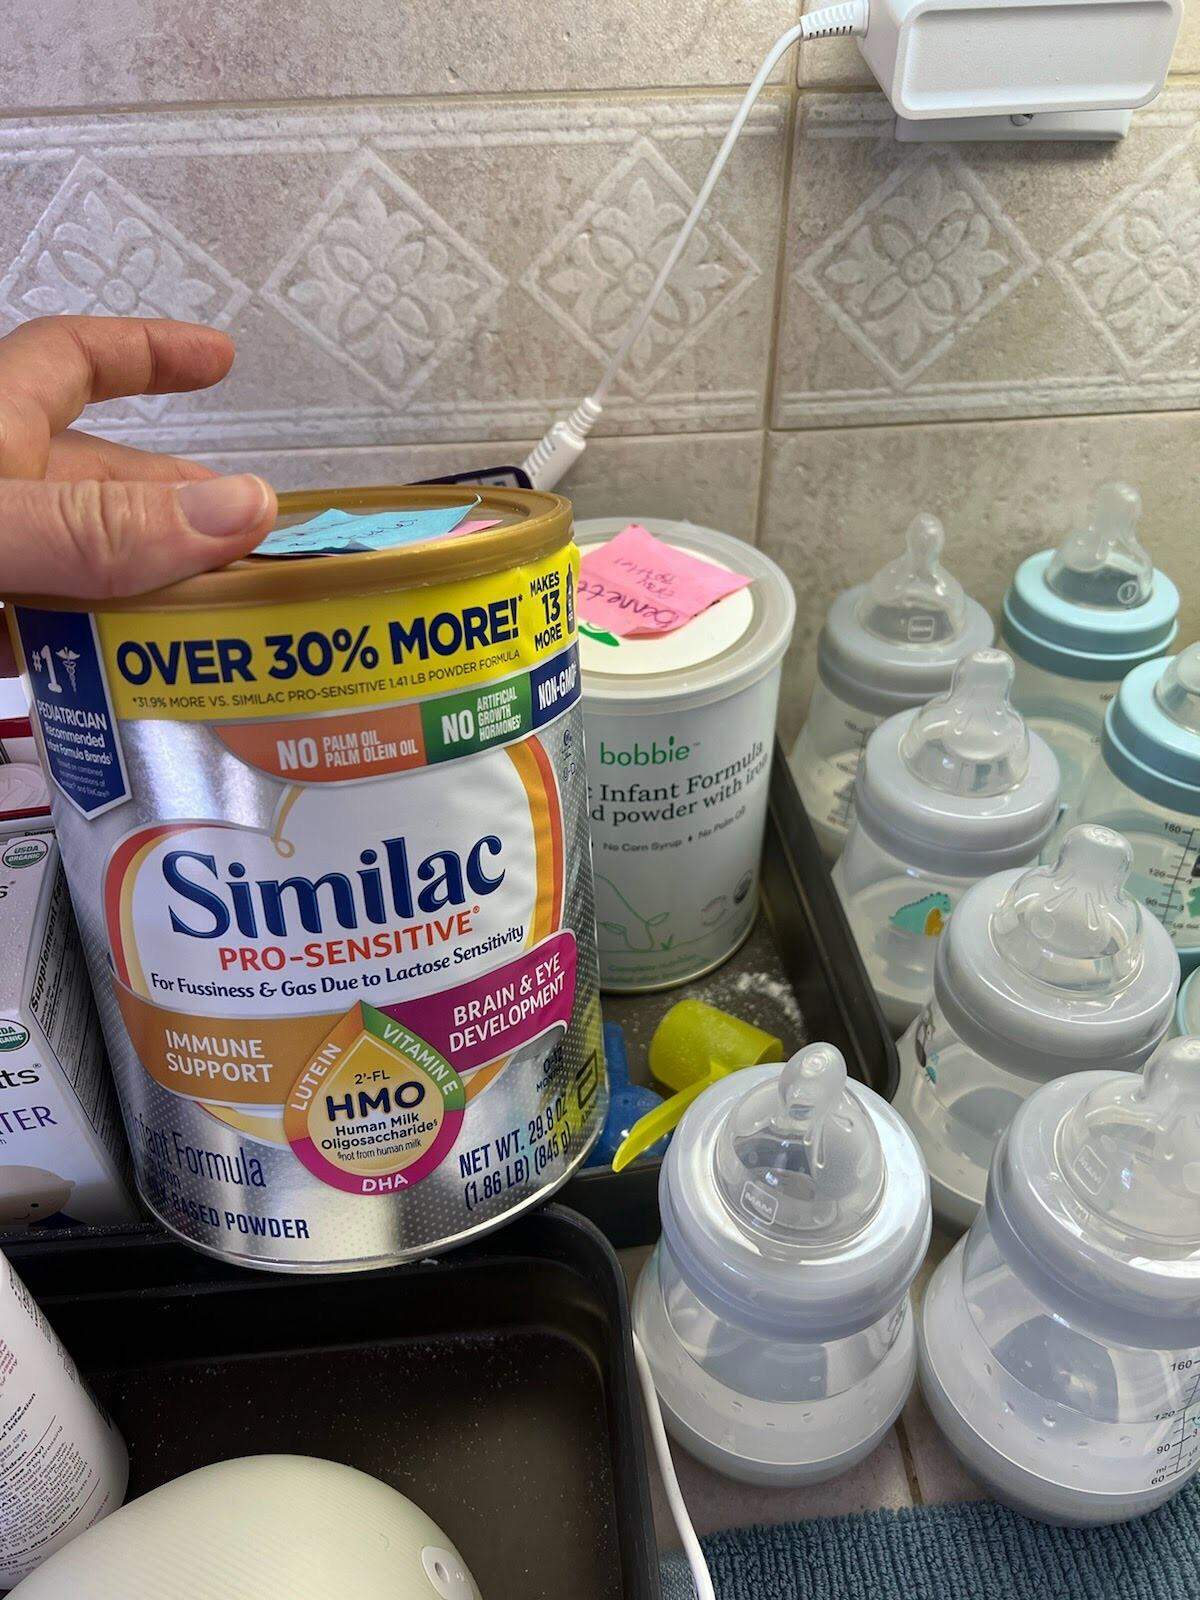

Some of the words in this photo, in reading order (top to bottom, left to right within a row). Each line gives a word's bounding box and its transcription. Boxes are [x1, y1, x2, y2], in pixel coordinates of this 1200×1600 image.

[530, 571, 560, 597] MAKES
[541, 590, 561, 625] 13
[535, 623, 563, 652] MORE
[31, 644, 63, 694] #1
[117, 639, 257, 686] OVER
[265, 625, 379, 680] 30%
[170, 697, 205, 708] MORE
[210, 696, 230, 708] VS.
[233, 692, 286, 706] SIMILAC
[288, 678, 387, 701] PRO-SENSITIVE
[389, 676, 409, 688] 1.41
[411, 673, 427, 685] LB
[429, 663, 478, 682] POWDER
[479, 649, 520, 671] FORMULA
[36, 698, 108, 731] PEDIATRICIAN
[476, 686, 518, 712] ARTIFICIAL
[44, 721, 105, 749] Recommended
[441, 709, 475, 745] NO
[478, 703, 512, 725] GROWTH
[276, 737, 319, 770] NO
[324, 748, 362, 768] PALM
[363, 743, 398, 763] OLEIN
[401, 739, 418, 756] OIL
[322, 732, 360, 751] PALM
[361, 730, 381, 747] OIL
[600, 783, 680, 803] Infant
[686, 741, 764, 796] Formula
[613, 799, 698, 827] powder
[703, 776, 743, 809] with
[746, 751, 770, 784] iron
[698, 829, 712, 841] No
[713, 817, 734, 835] Palm
[735, 805, 747, 821] Oil
[8, 852, 41, 862] ORGANIC
[14, 844, 39, 855] USDA
[603, 843, 620, 851] No
[621, 842, 650, 852] Corn
[651, 838, 683, 852] Syrup
[162, 834, 506, 939] Similac
[1149, 867, 1166, 879] 120
[32, 906, 58, 1013] Supplement
[151, 972, 174, 992] For
[178, 977, 255, 998] Fussiness
[259, 981, 278, 998] &
[281, 979, 317, 997] Gas
[322, 974, 359, 993] Due
[361, 971, 381, 987] to
[386, 955, 451, 984] Lactose
[454, 925, 525, 965] Sensitivity
[453, 983, 516, 1027] BRAIN
[519, 972, 533, 996] &
[536, 952, 561, 986] EYE
[449, 971, 567, 1053] DEVELOPMENT
[0, 1025, 16, 1035] DA
[0, 1035, 24, 1045] GANIC
[165, 1029, 266, 1060] IMMUNE
[165, 1053, 273, 1083] SUPPORT
[382, 1023, 450, 1083] VITAMIN
[443, 1078, 458, 1096] E
[290, 1043, 342, 1111] LUTEIN
[325, 1080, 426, 1121] HMO
[335, 1120, 386, 1137] Human
[390, 1112, 420, 1130] Milk
[355, 1148, 375, 1160] from
[376, 1144, 404, 1158] human
[404, 1139, 422, 1152] milk
[459, 1142, 491, 1179] NET
[495, 1129, 525, 1162] WT.
[528, 1108, 555, 1146] 29.8
[173, 1132, 267, 1188] Formula
[464, 1169, 502, 1212] (1.86
[506, 1154, 530, 1189] LB)
[535, 1136, 560, 1177] (845
[361, 1173, 409, 1194] DHA
[225, 1213, 310, 1240] POWDER
[1171, 1360, 1194, 1372] 160
[1, 1405, 22, 1429] more
[7, 1392, 37, 1431] infection
[1153, 1409, 1176, 1421] 120
[1156, 1443, 1171, 1455] 90
[9, 1467, 25, 1482] use
[1151, 1474, 1165, 1486] 60
[30, 1535, 49, 1549] after
[49, 1520, 68, 1537] each
[67, 1506, 81, 1520] use
